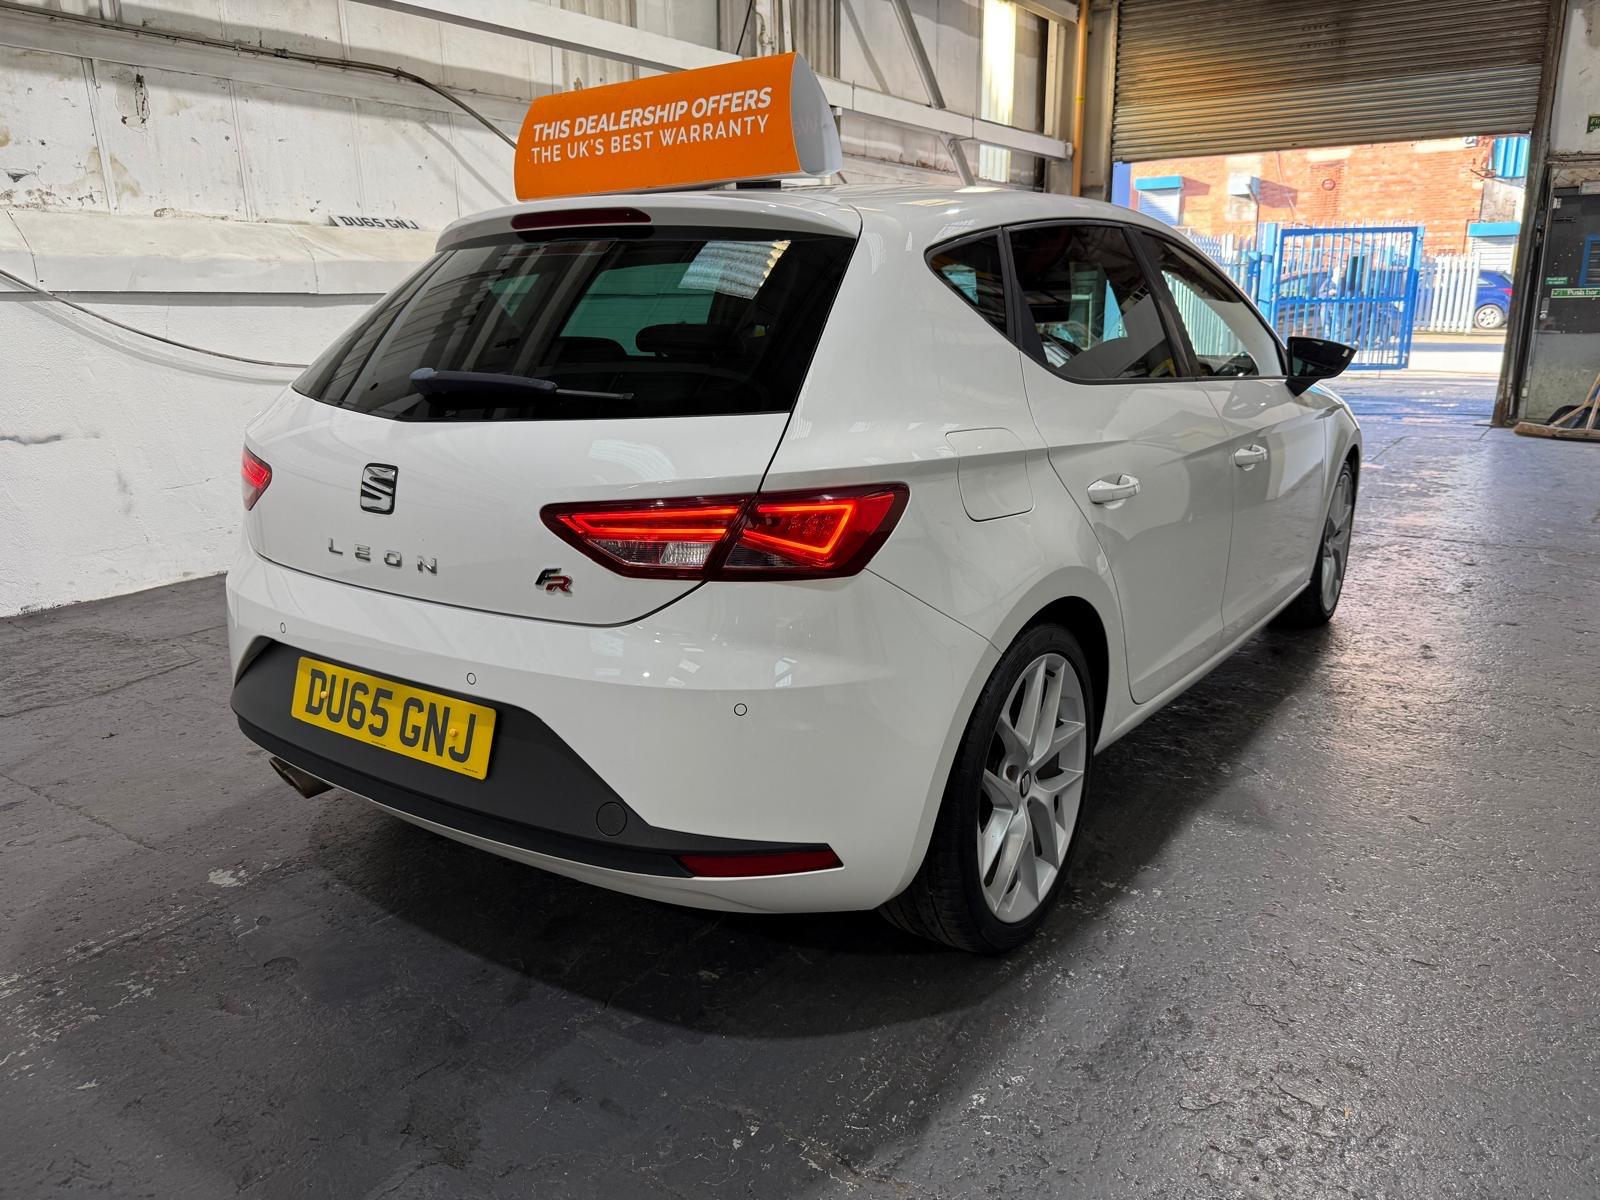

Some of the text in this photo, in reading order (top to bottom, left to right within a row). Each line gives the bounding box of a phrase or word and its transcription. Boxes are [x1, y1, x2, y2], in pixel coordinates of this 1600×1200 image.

[533, 87, 772, 142] THIS DEALERSHIP OFFERS
[531, 113, 769, 164] THE UK'S BEST WARRANTY
[338, 216, 419, 230] DU65 GNJ
[328, 537, 438, 576] LEON
[535, 567, 573, 594] FR
[305, 668, 477, 764] DU65 GNJ
